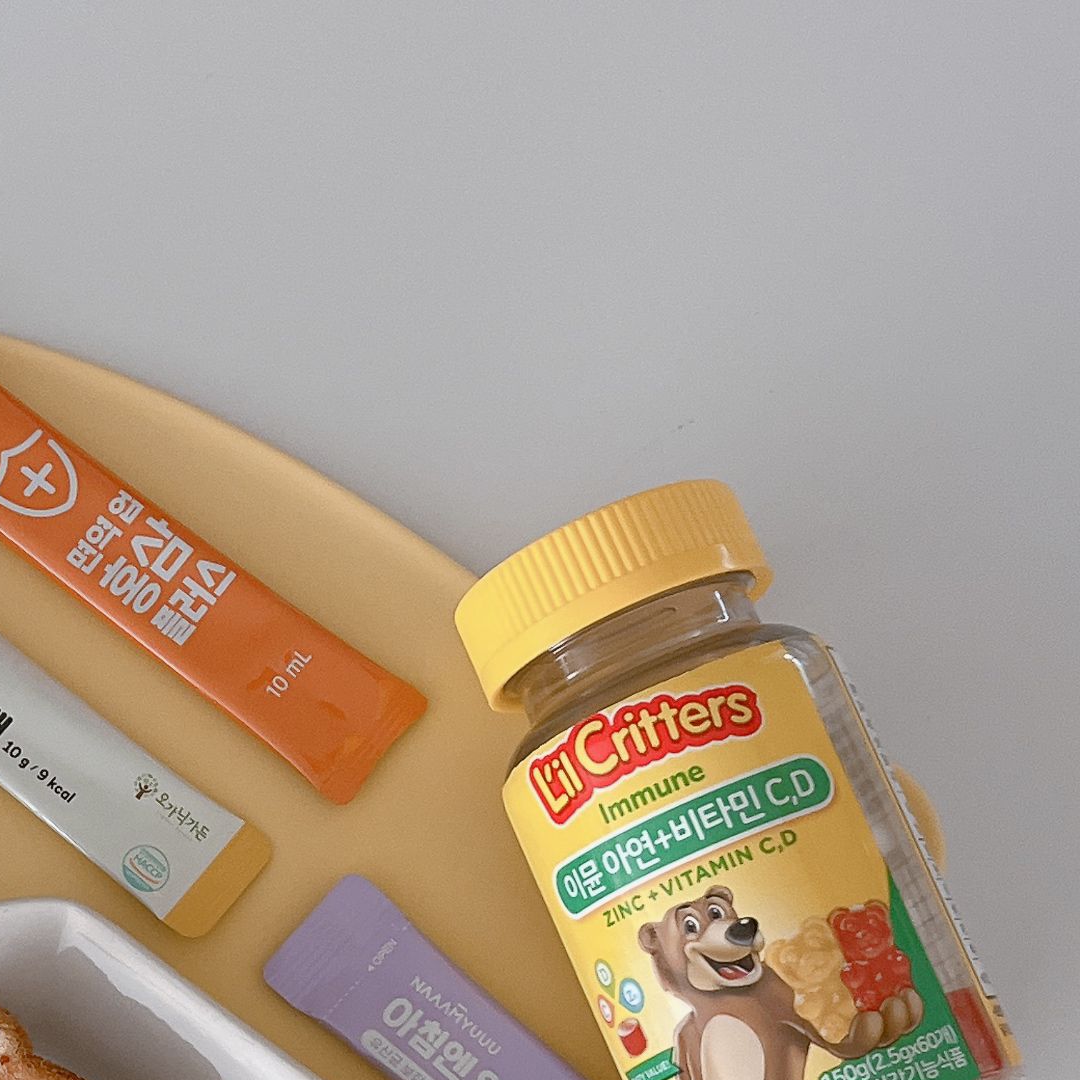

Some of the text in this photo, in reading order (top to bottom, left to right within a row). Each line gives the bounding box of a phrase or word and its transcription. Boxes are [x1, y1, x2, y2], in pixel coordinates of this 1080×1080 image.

[66, 489, 145, 575] 면역 업
[99, 516, 194, 614] 홍삼
[150, 559, 237, 646] 플러스
[266, 650, 313, 698] 10 mL
[575, 691, 754, 776] Critters
[2, 740, 22, 759] 10
[18, 757, 30, 769] g
[36, 769, 49, 781] 9
[47, 776, 76, 803] kcal
[599, 764, 707, 825] Immune
[155, 793, 210, 841] 오가닉가든
[563, 859, 607, 900] 이뮨
[765, 768, 816, 806] C,D
[133, 853, 162, 879] HACCP
[603, 895, 645, 928] ZINC
[659, 846, 753, 897] VITAMIN
[759, 828, 798, 855] C,D
[372, 938, 398, 966] OPEN
